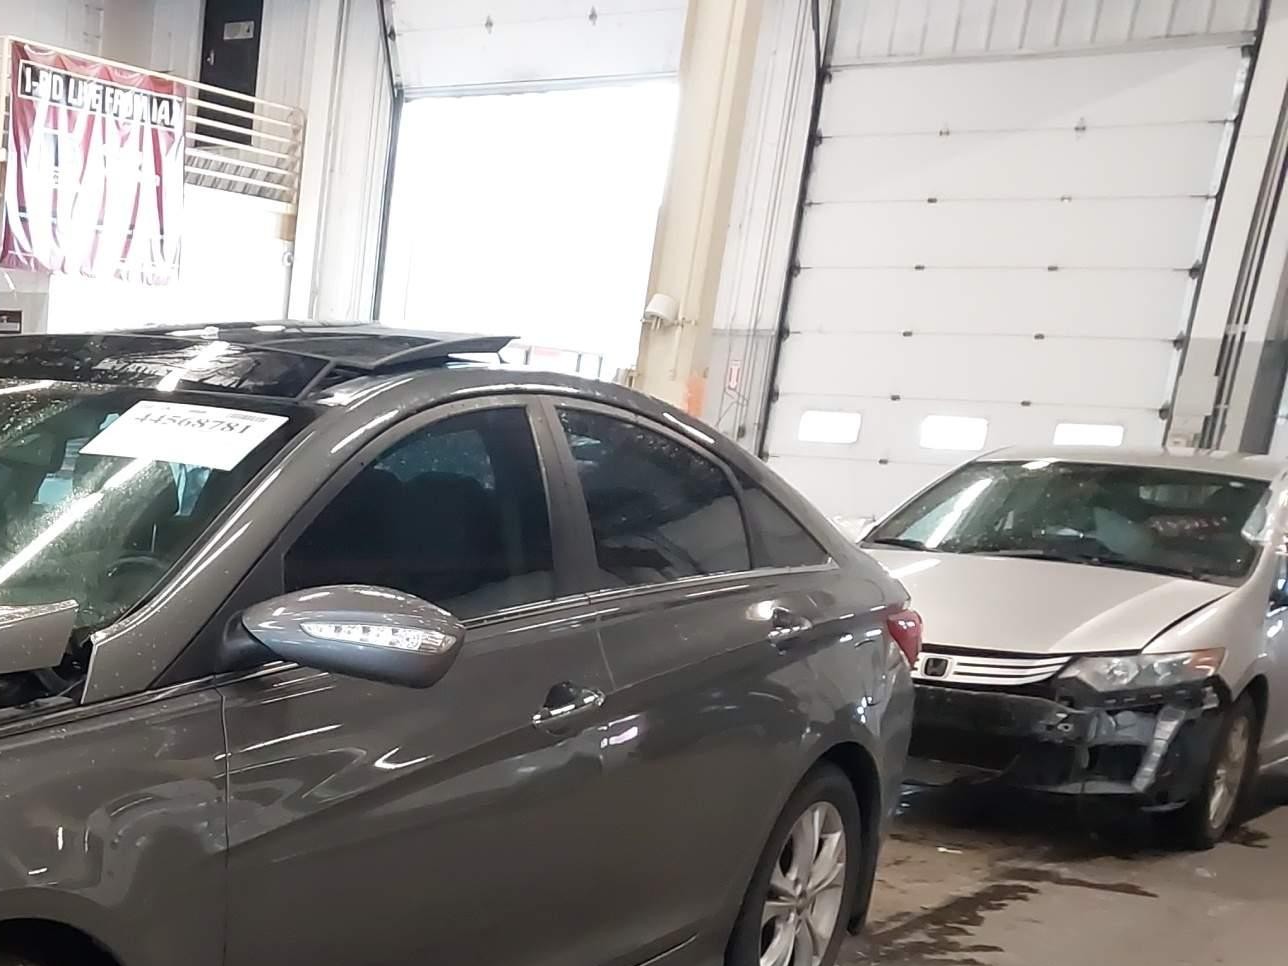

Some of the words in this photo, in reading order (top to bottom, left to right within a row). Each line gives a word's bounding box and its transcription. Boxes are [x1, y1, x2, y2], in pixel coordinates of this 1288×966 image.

[68, 77, 101, 111] LIVE
[105, 86, 149, 122] FROM
[135, 412, 252, 434] 44568781
